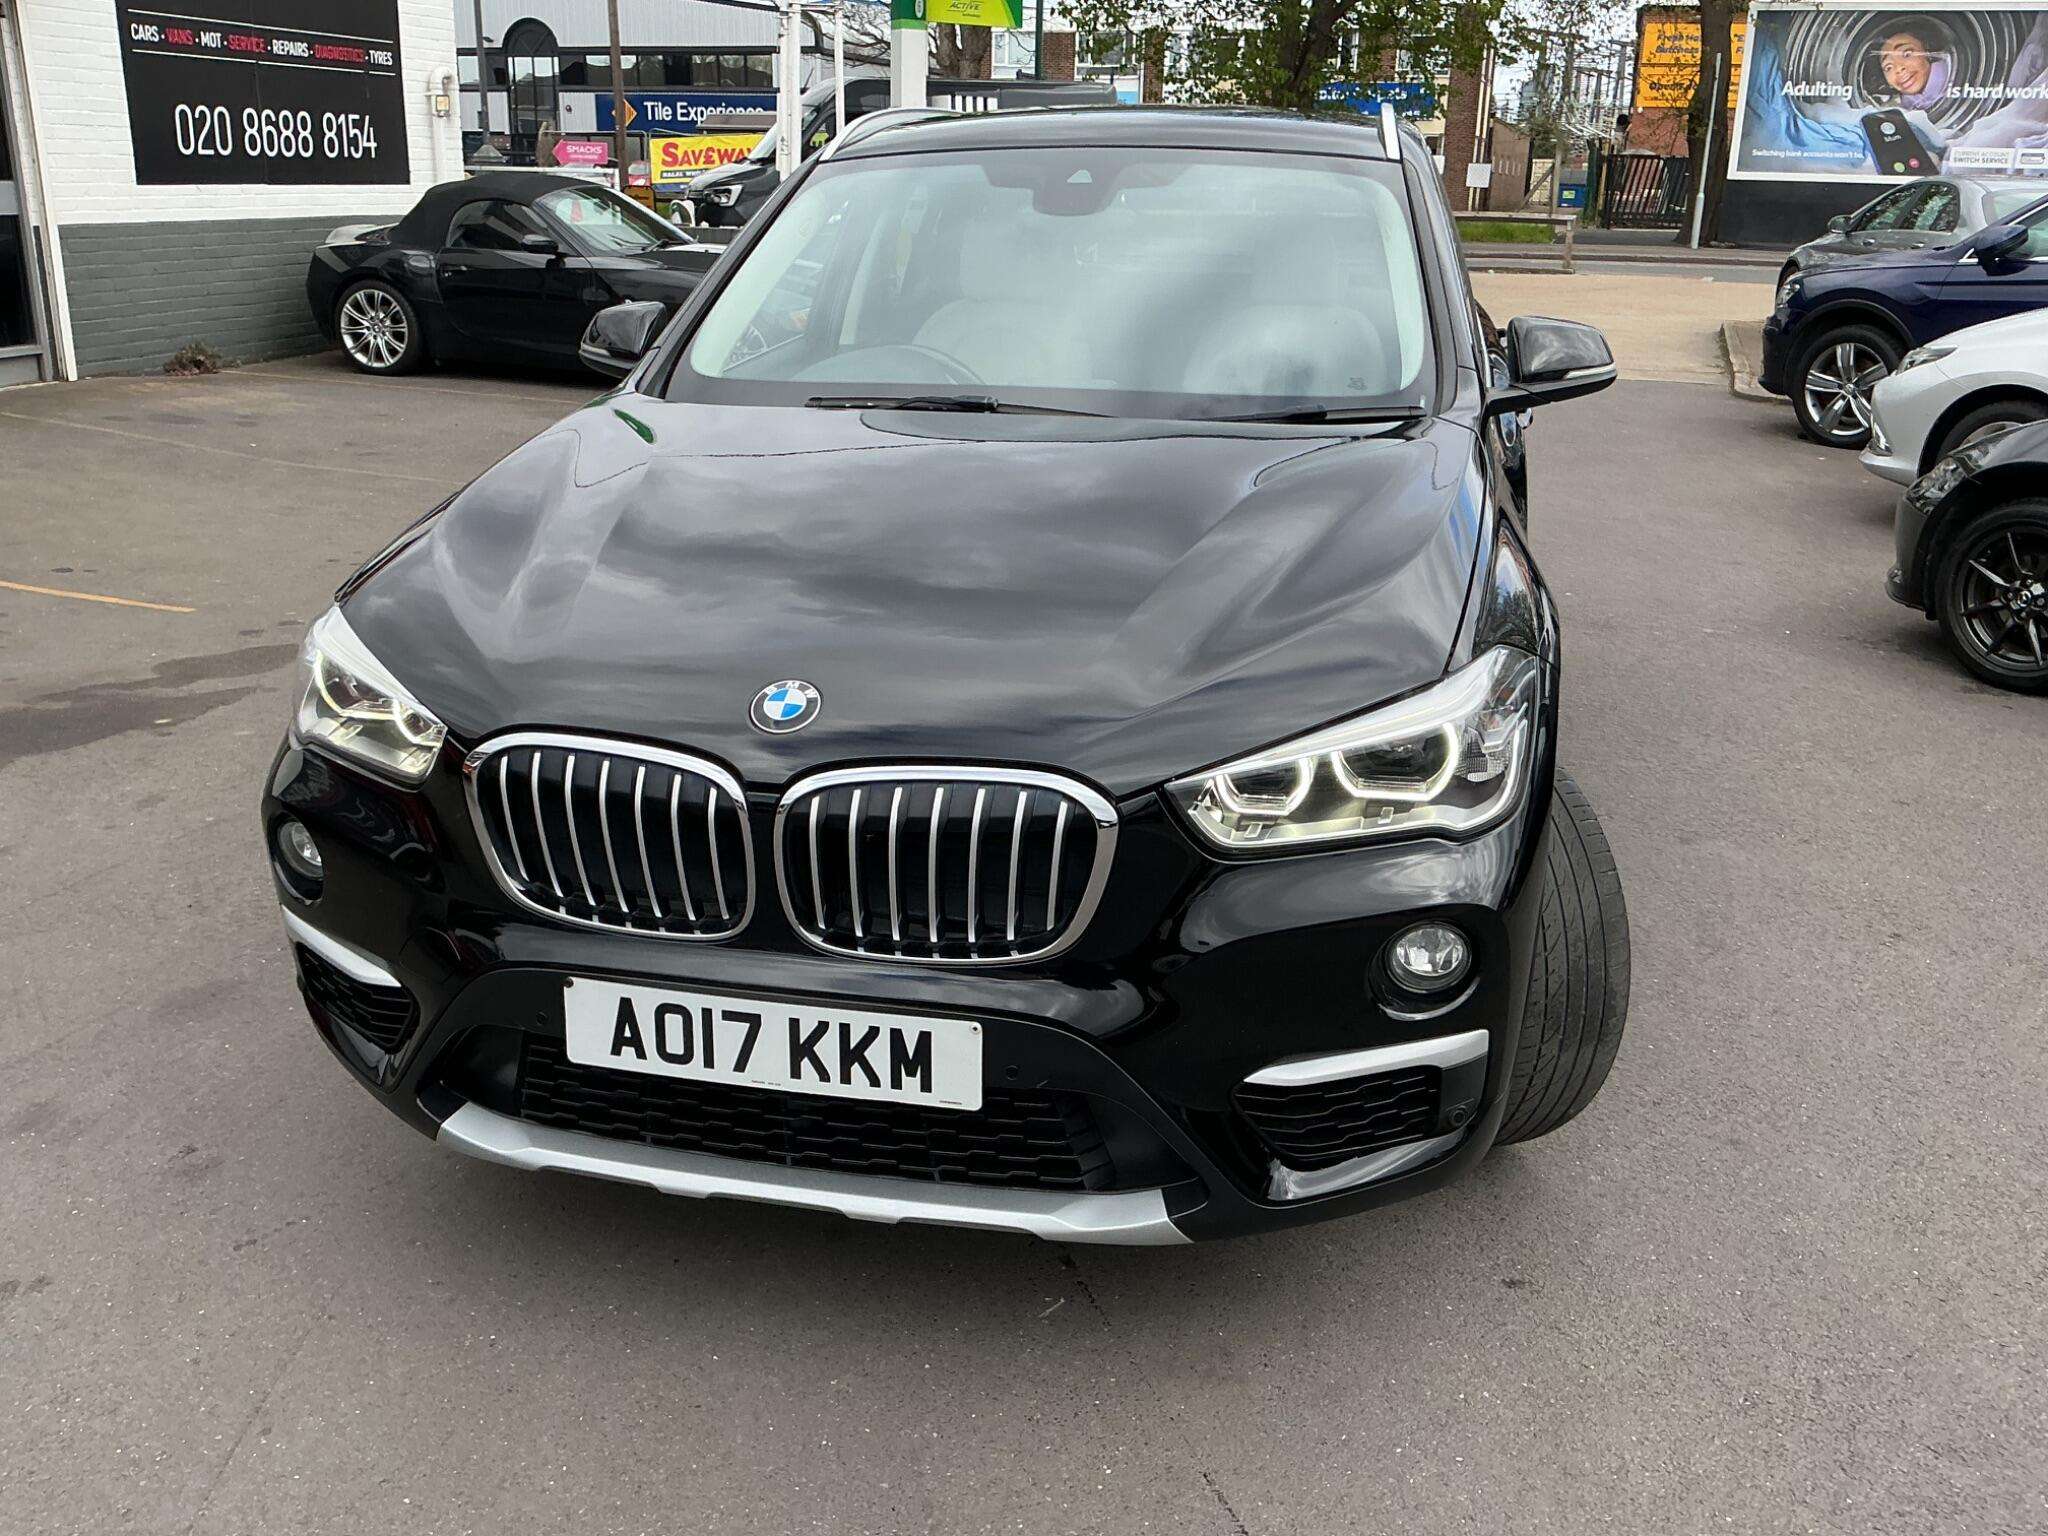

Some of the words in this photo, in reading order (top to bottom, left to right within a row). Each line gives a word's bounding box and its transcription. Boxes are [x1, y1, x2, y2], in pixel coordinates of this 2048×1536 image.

[130, 23, 159, 42] CARS
[165, 27, 194, 46] VANS
[200, 31, 222, 49] MOT
[228, 34, 267, 53] SERVICE
[272, 39, 310, 58] REPAIRS
[313, 44, 365, 63] DIAGNOSTICS
[368, 49, 393, 66] TYRES
[1781, 80, 1853, 101] Adulting
[1946, 82, 1961, 98] is
[1963, 82, 2004, 99] hard
[643, 101, 672, 121] Tile
[174, 103, 233, 156] 020
[242, 107, 314, 158] 8688
[322, 112, 378, 159] 8154
[566, 145, 602, 154] SMACKS
[1752, 148, 1785, 158] Switching
[610, 997, 762, 1073] AO17
[788, 1017, 932, 1093] KKM
